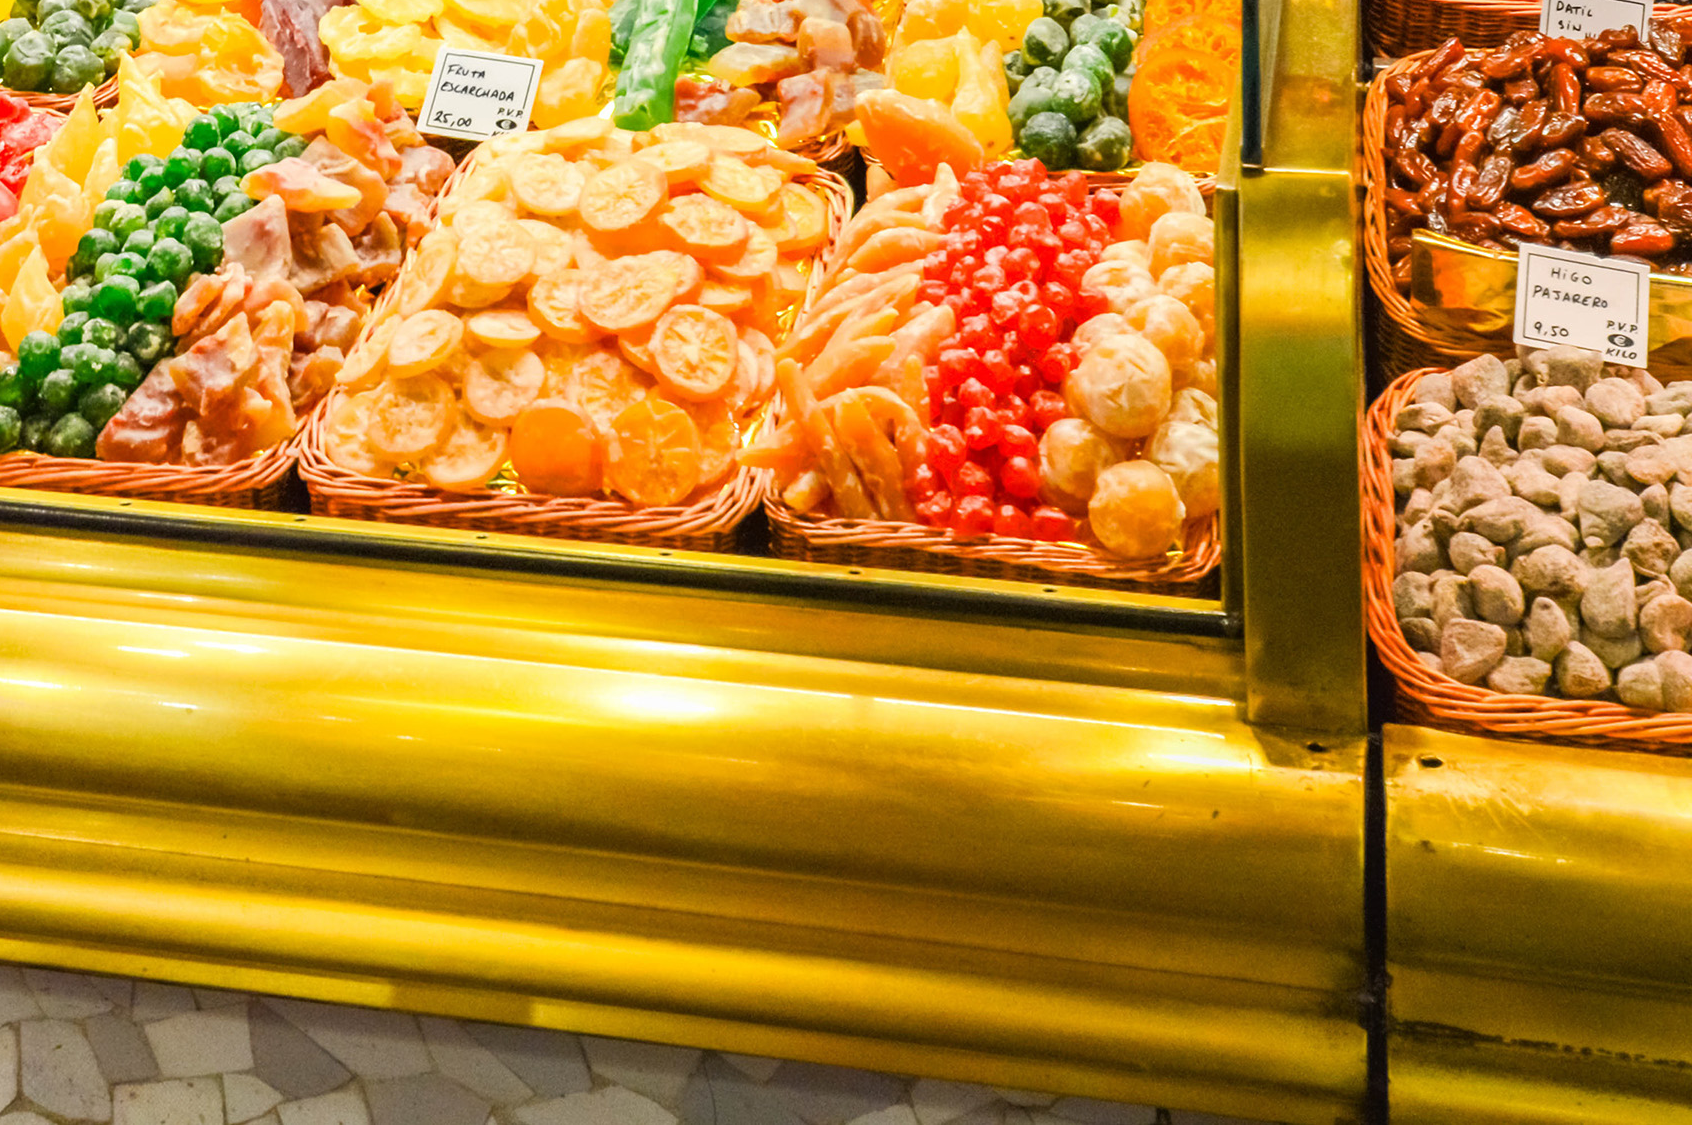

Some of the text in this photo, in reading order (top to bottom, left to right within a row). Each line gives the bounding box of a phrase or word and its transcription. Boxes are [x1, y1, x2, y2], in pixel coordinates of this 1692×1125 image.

[446, 63, 486, 79] FRUTA
[440, 80, 516, 103] ESCARCHADA
[433, 110, 473, 128] 25,00
[1532, 284, 1609, 309] PAJARERO
[1533, 321, 1570, 338] 9,50
[1605, 347, 1638, 361] KILO
